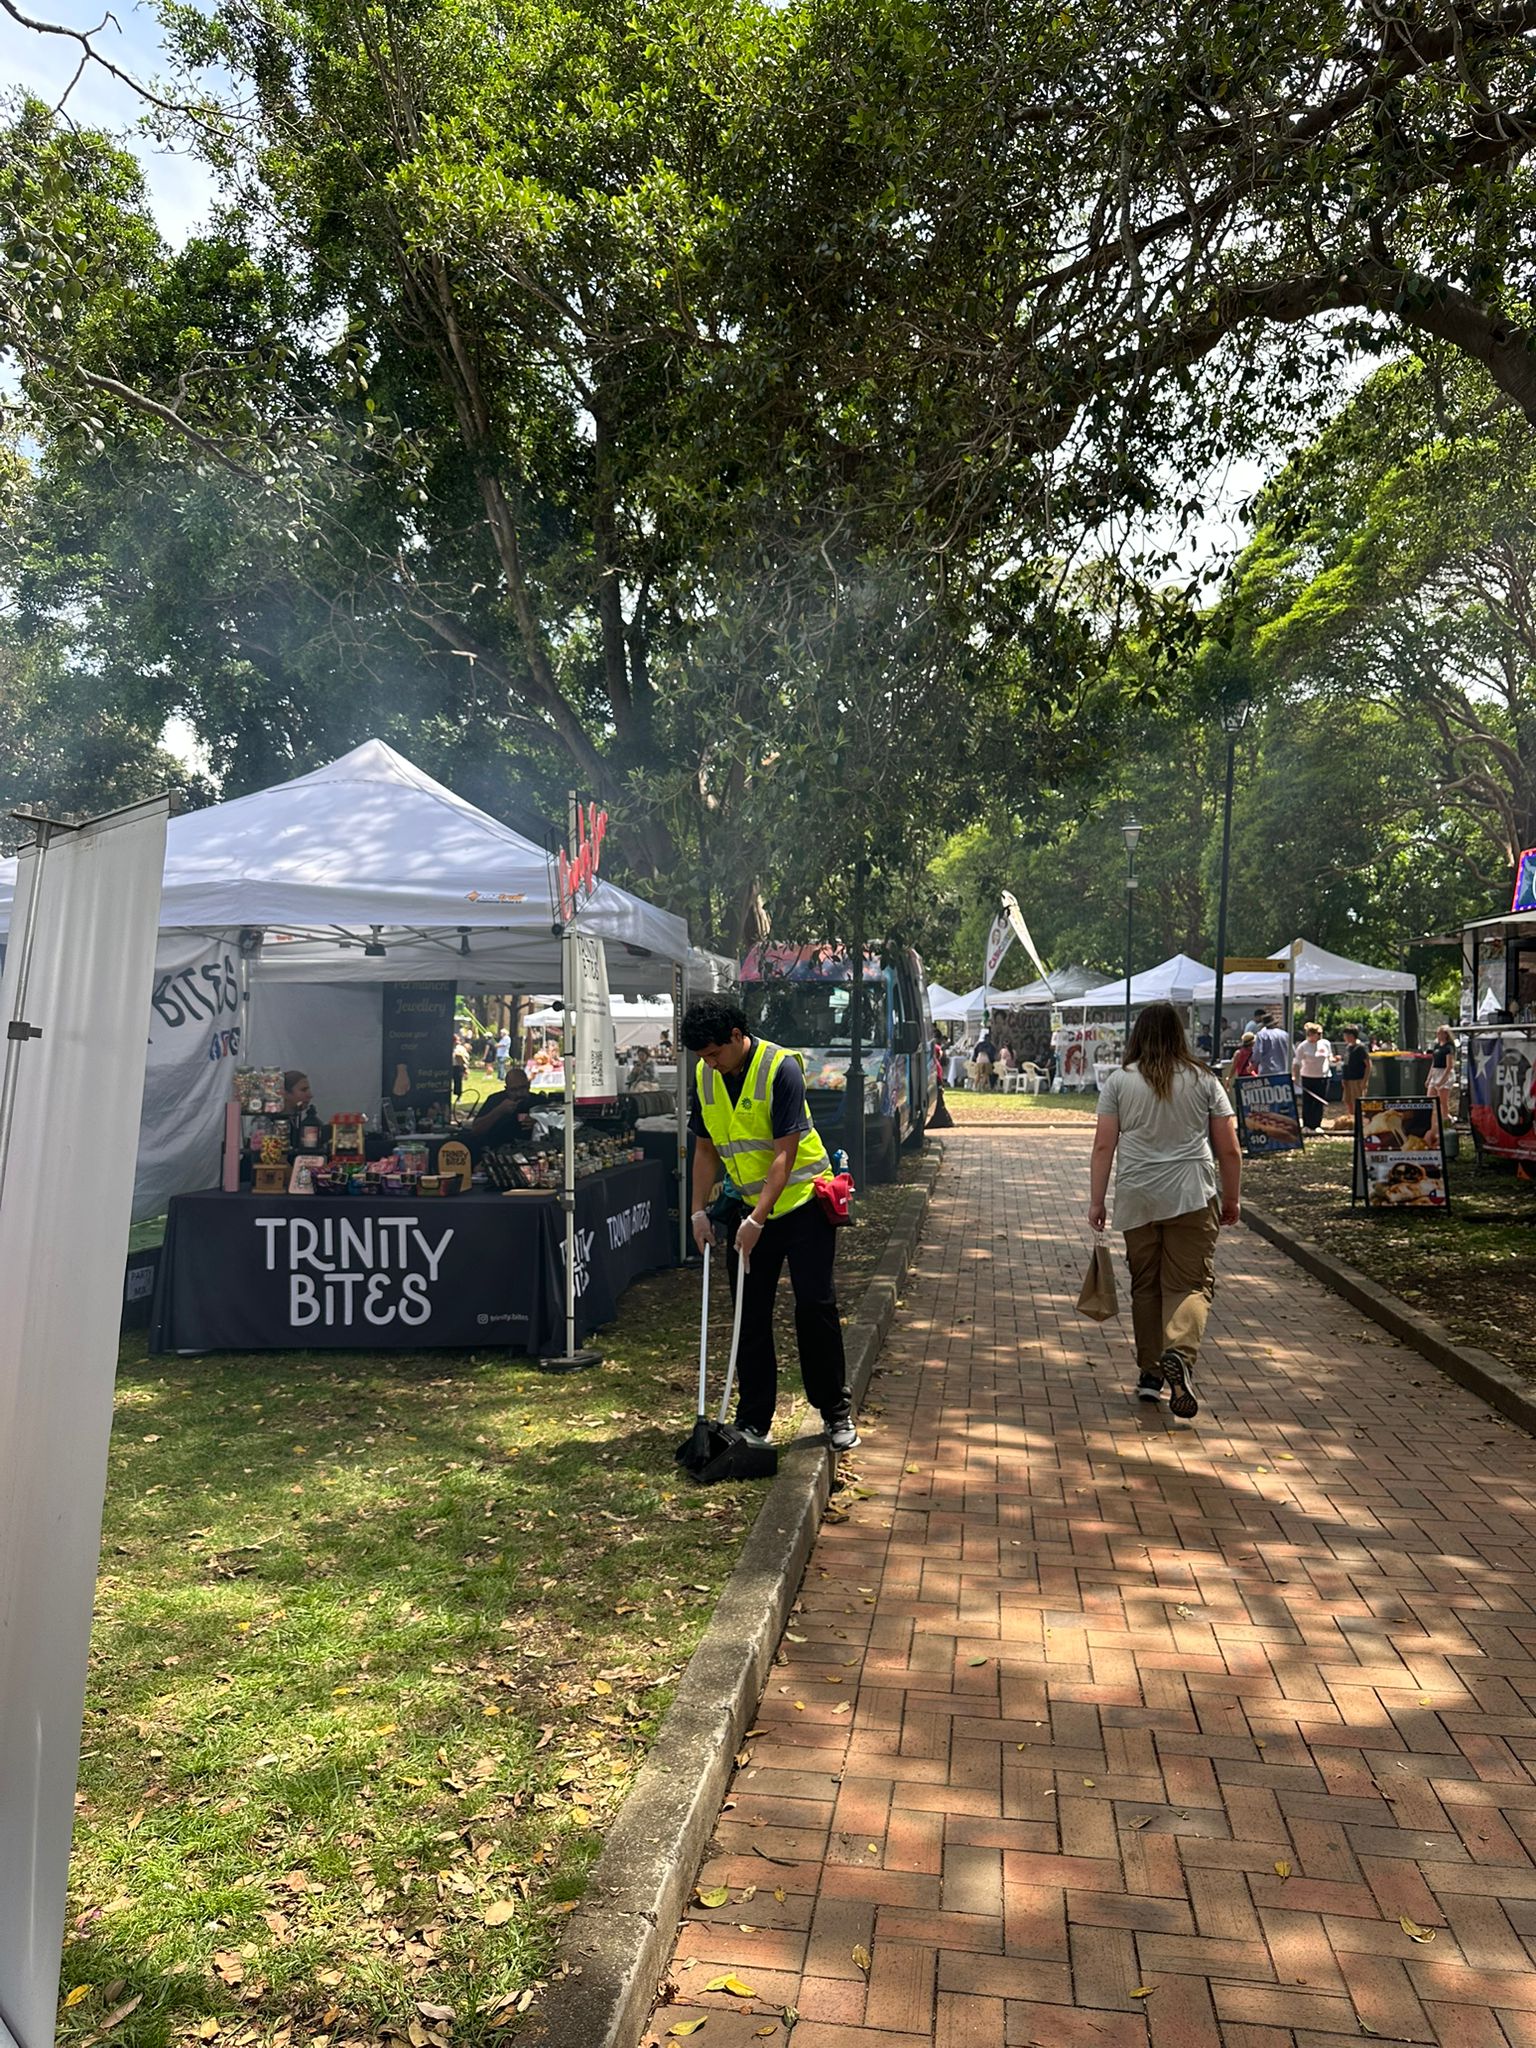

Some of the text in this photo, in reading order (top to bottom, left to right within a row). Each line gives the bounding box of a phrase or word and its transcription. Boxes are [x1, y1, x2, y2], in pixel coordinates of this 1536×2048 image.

[1263, 1077, 1270, 1086] A
[1496, 1064, 1519, 1085] EAT
[1240, 1084, 1293, 1106] HOTDOG
[1503, 1086, 1521, 1108] ME
[1498, 1104, 1519, 1125] CO
[1250, 1134, 1267, 1144] $10
[255, 1217, 455, 1281] TRINITY
[290, 1272, 432, 1327] BITES
